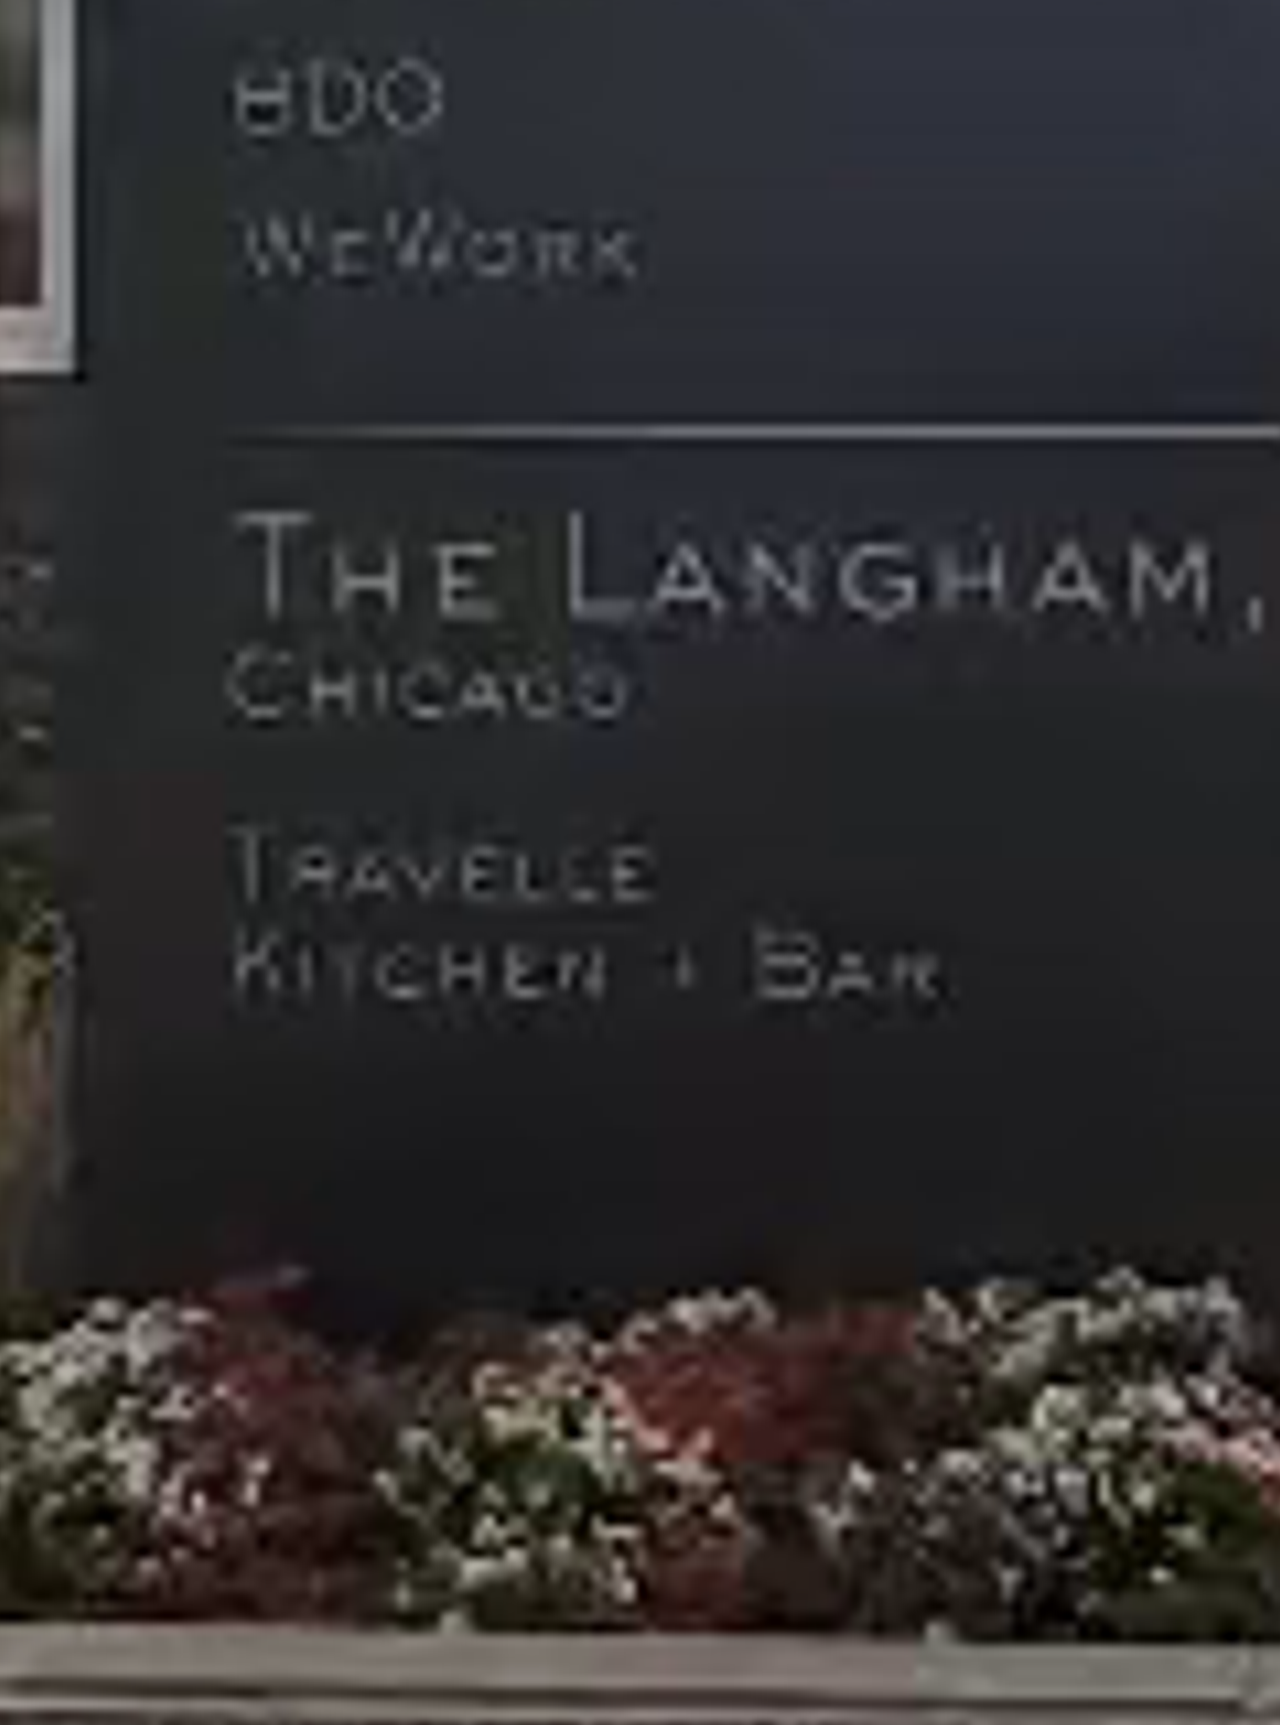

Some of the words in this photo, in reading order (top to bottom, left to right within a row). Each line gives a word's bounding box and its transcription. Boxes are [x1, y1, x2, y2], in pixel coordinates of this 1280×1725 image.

[232, 55, 446, 138] BDO
[233, 509, 499, 621] THE
[567, 509, 1266, 634] LANGHAM,
[223, 644, 630, 722] CHICAGO
[230, 824, 655, 906] TRAVELLE
[232, 927, 608, 1002] KITCHEN
